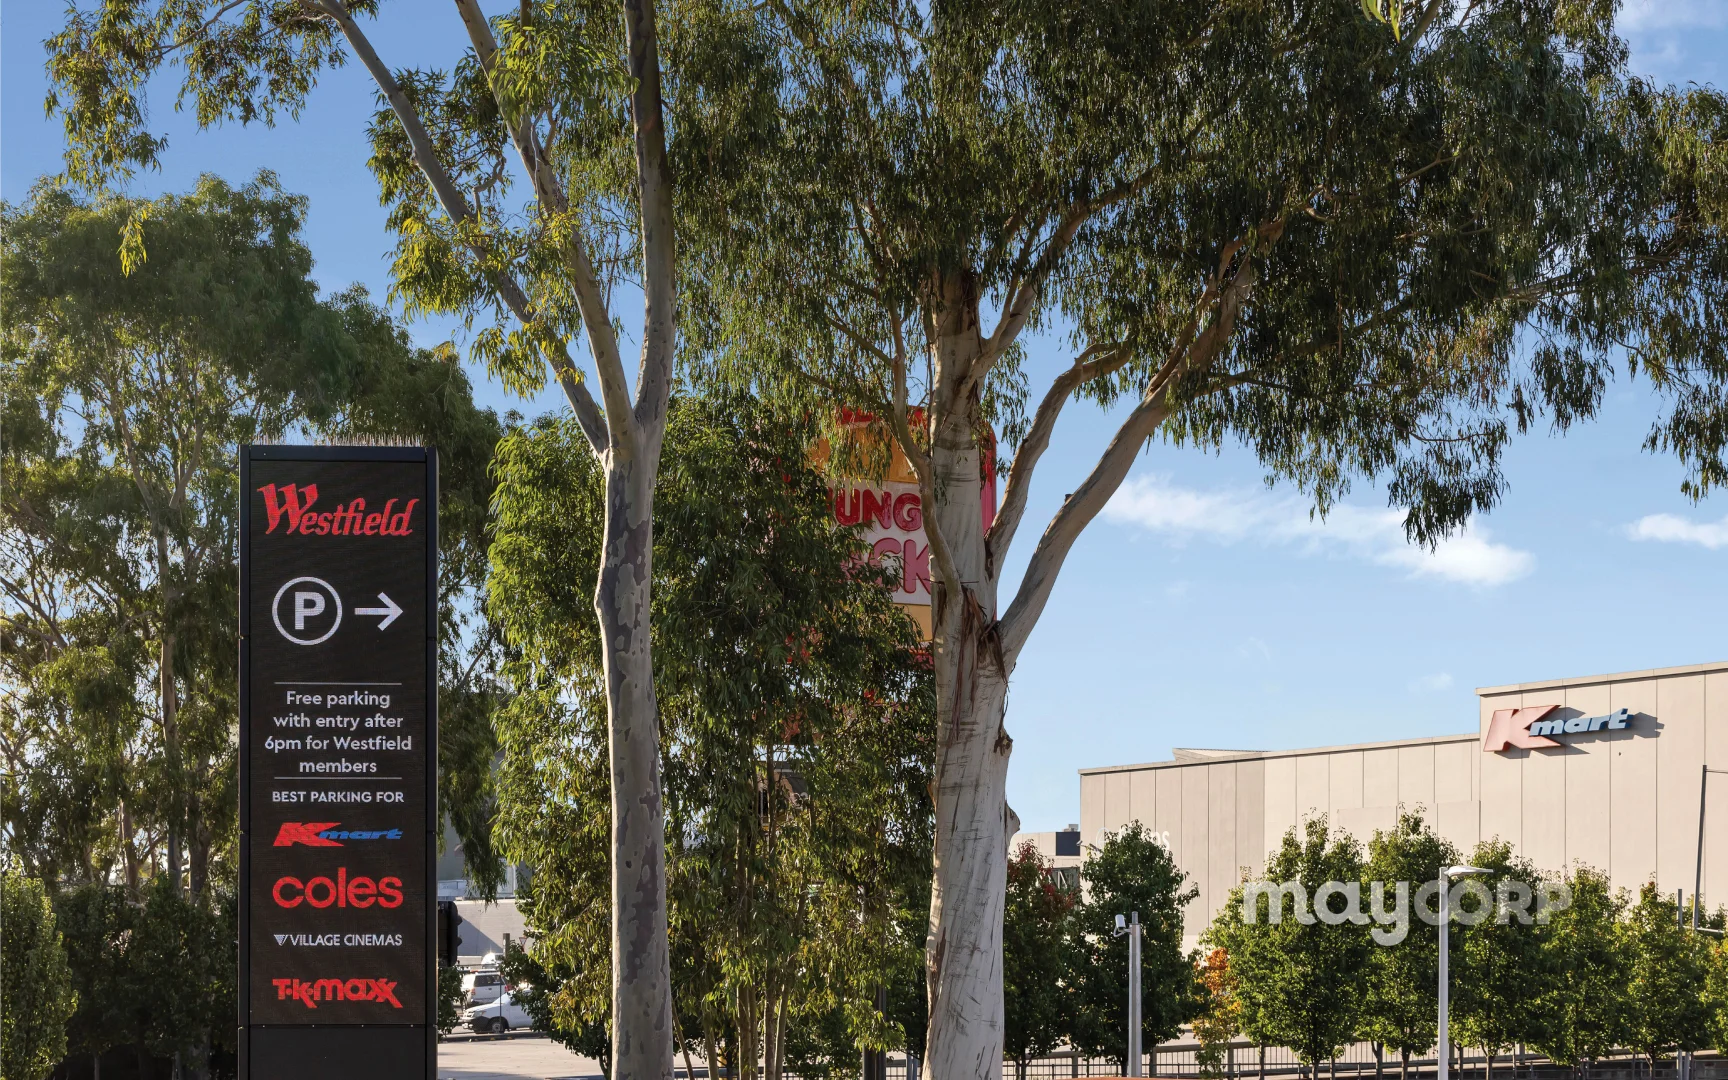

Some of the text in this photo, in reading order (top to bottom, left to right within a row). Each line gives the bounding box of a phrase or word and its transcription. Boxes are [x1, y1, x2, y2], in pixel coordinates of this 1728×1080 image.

[256, 483, 420, 536] Westfield
[827, 486, 923, 532] UNG
[294, 591, 326, 630] P
[286, 690, 391, 709] Free parking
[273, 713, 404, 731] with entry after
[1483, 704, 1629, 752] Kmart
[264, 735, 412, 753] 6pm for Westfield
[299, 758, 377, 773] members
[272, 791, 405, 803] BEST PARKING FOR
[272, 822, 403, 847] Kmart
[272, 867, 404, 909] coles
[290, 934, 403, 946] VILLAGE CINEMAS
